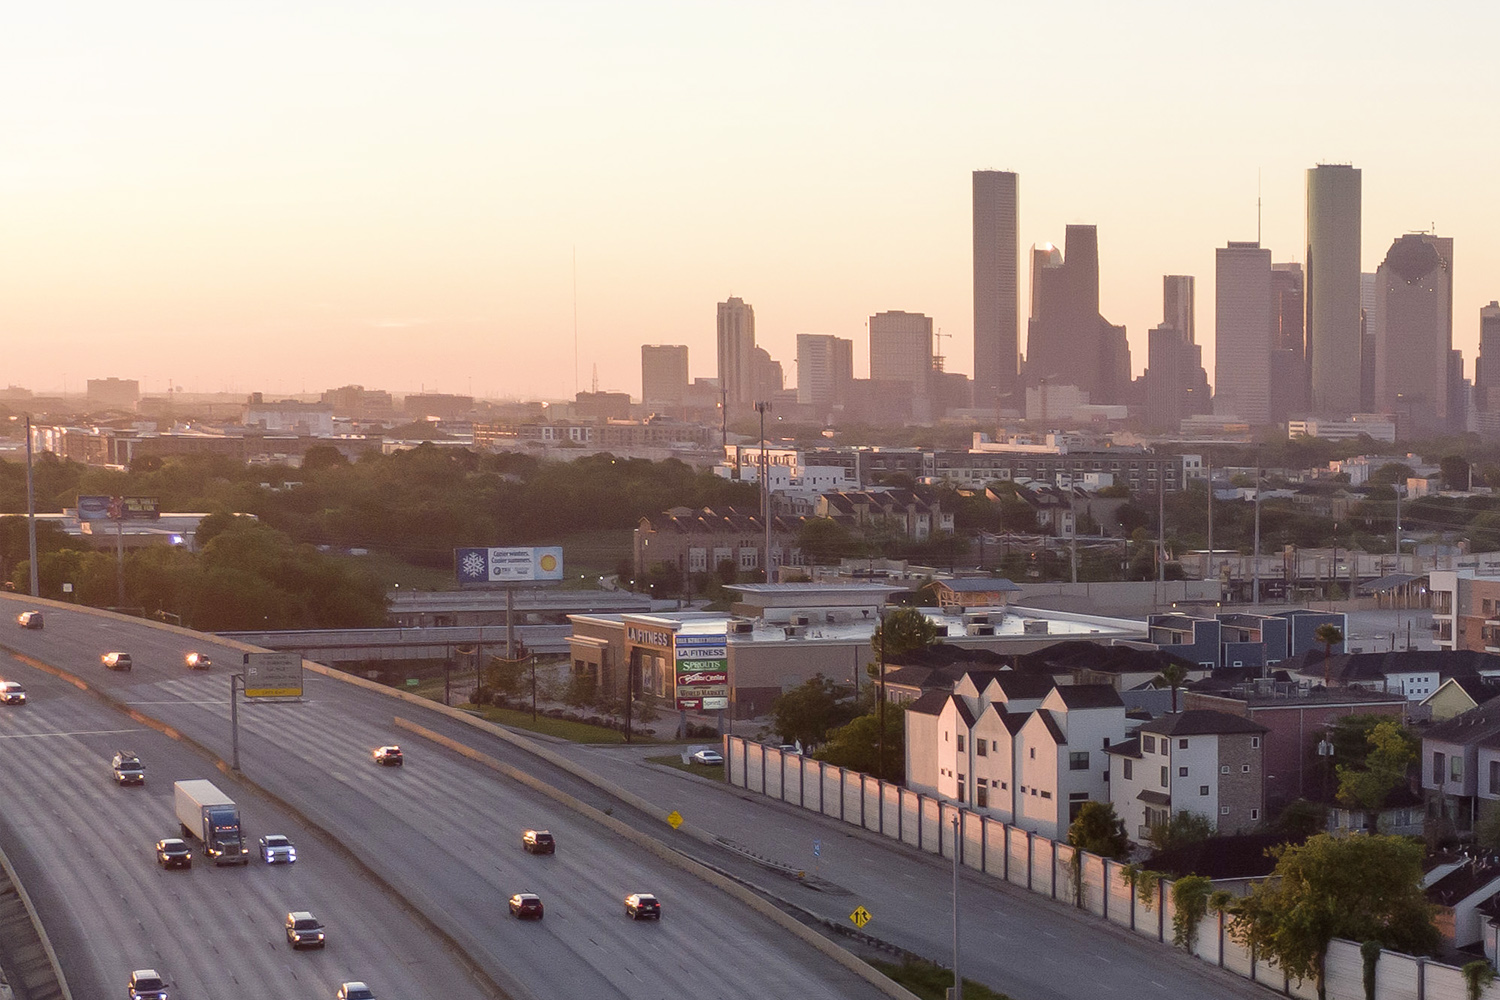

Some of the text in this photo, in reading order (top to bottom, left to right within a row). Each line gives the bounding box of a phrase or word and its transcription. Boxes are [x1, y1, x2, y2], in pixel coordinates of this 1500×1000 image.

[627, 627, 635, 639] LA
[637, 629, 668, 646] FITNESS
[690, 649, 725, 657] FITNESS
